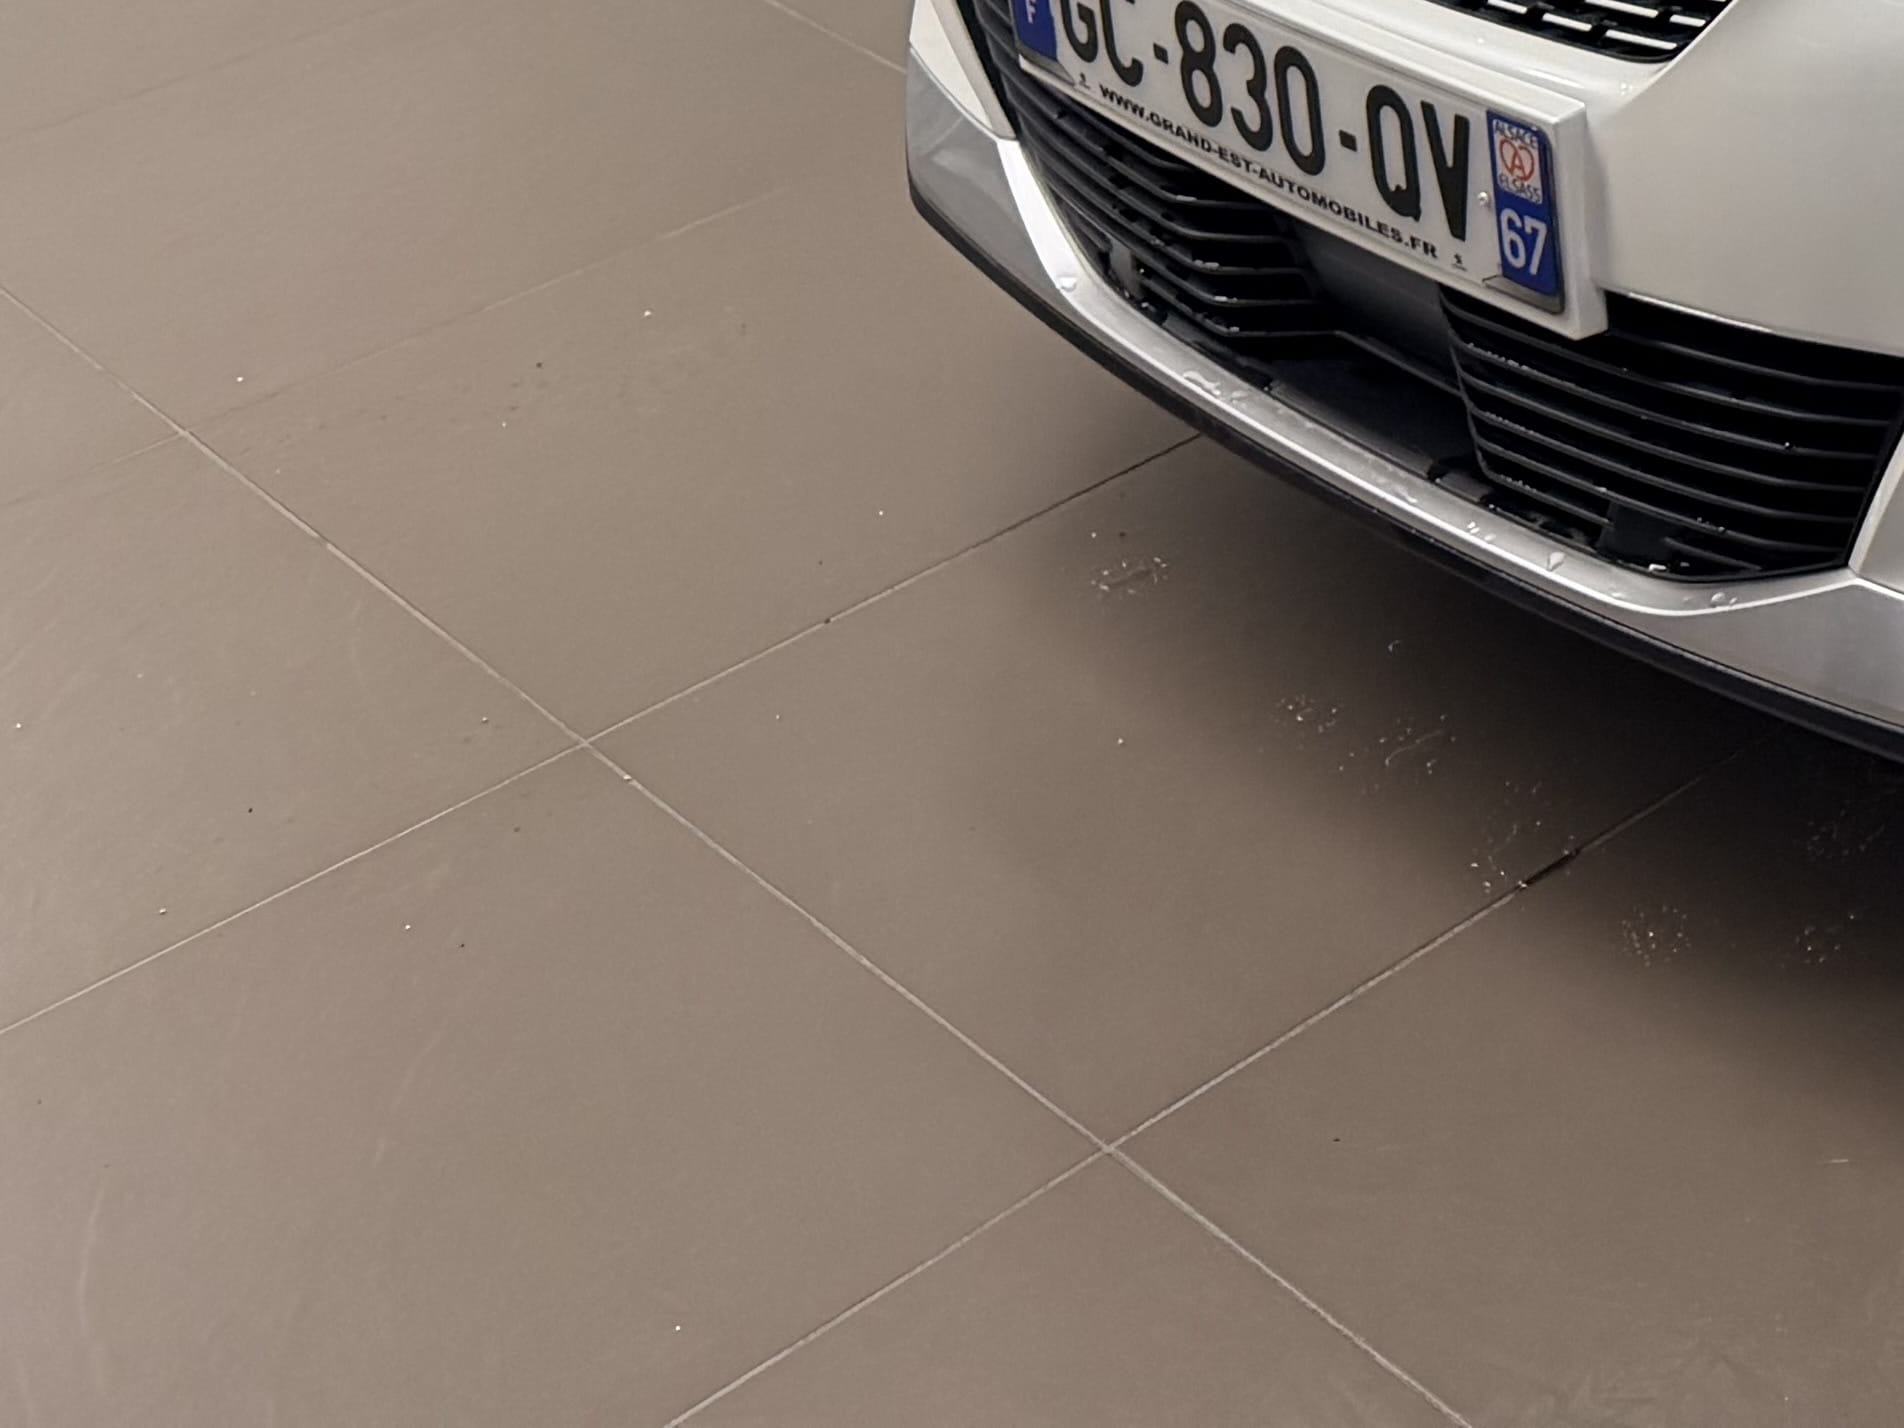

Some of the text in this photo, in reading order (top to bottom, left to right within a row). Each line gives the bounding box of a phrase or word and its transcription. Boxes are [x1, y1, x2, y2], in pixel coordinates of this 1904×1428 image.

[1494, 120, 1539, 149] ALSACE
[1098, 83, 1438, 260] WWW.GRAND-EST-AUTOMOBILES.FR
[1501, 207, 1548, 276] 67
